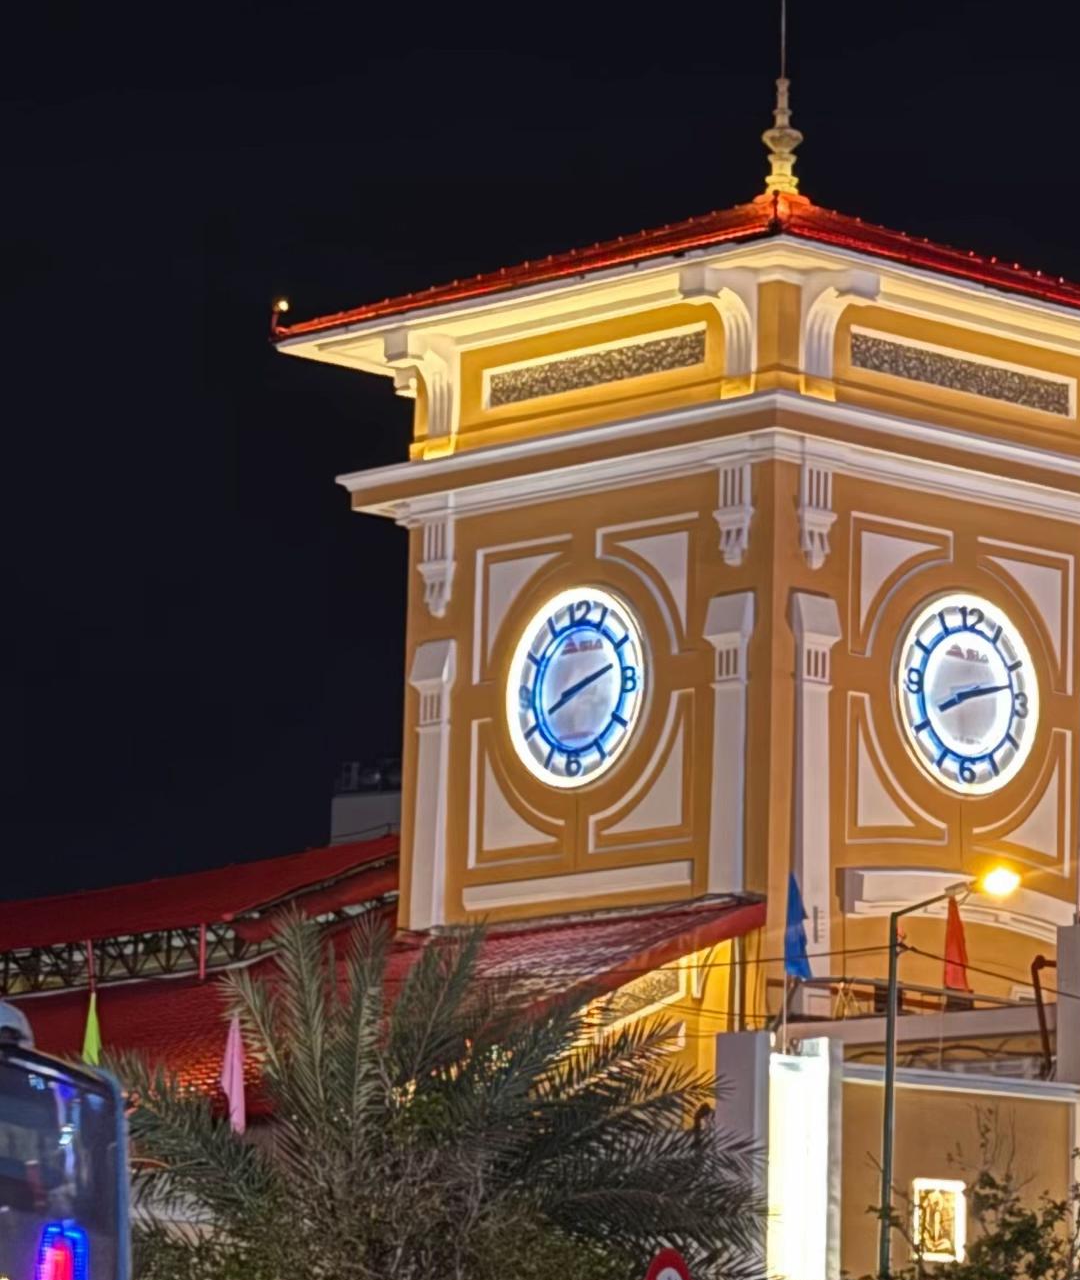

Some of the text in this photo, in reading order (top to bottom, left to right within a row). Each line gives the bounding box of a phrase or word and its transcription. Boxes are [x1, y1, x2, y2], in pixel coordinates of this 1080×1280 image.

[569, 600, 592, 624] 12
[959, 606, 984, 630] 12
[906, 668, 923, 693] 9
[1014, 692, 1028, 719] 3
[565, 751, 582, 777] 6
[960, 760, 976, 783] 6
